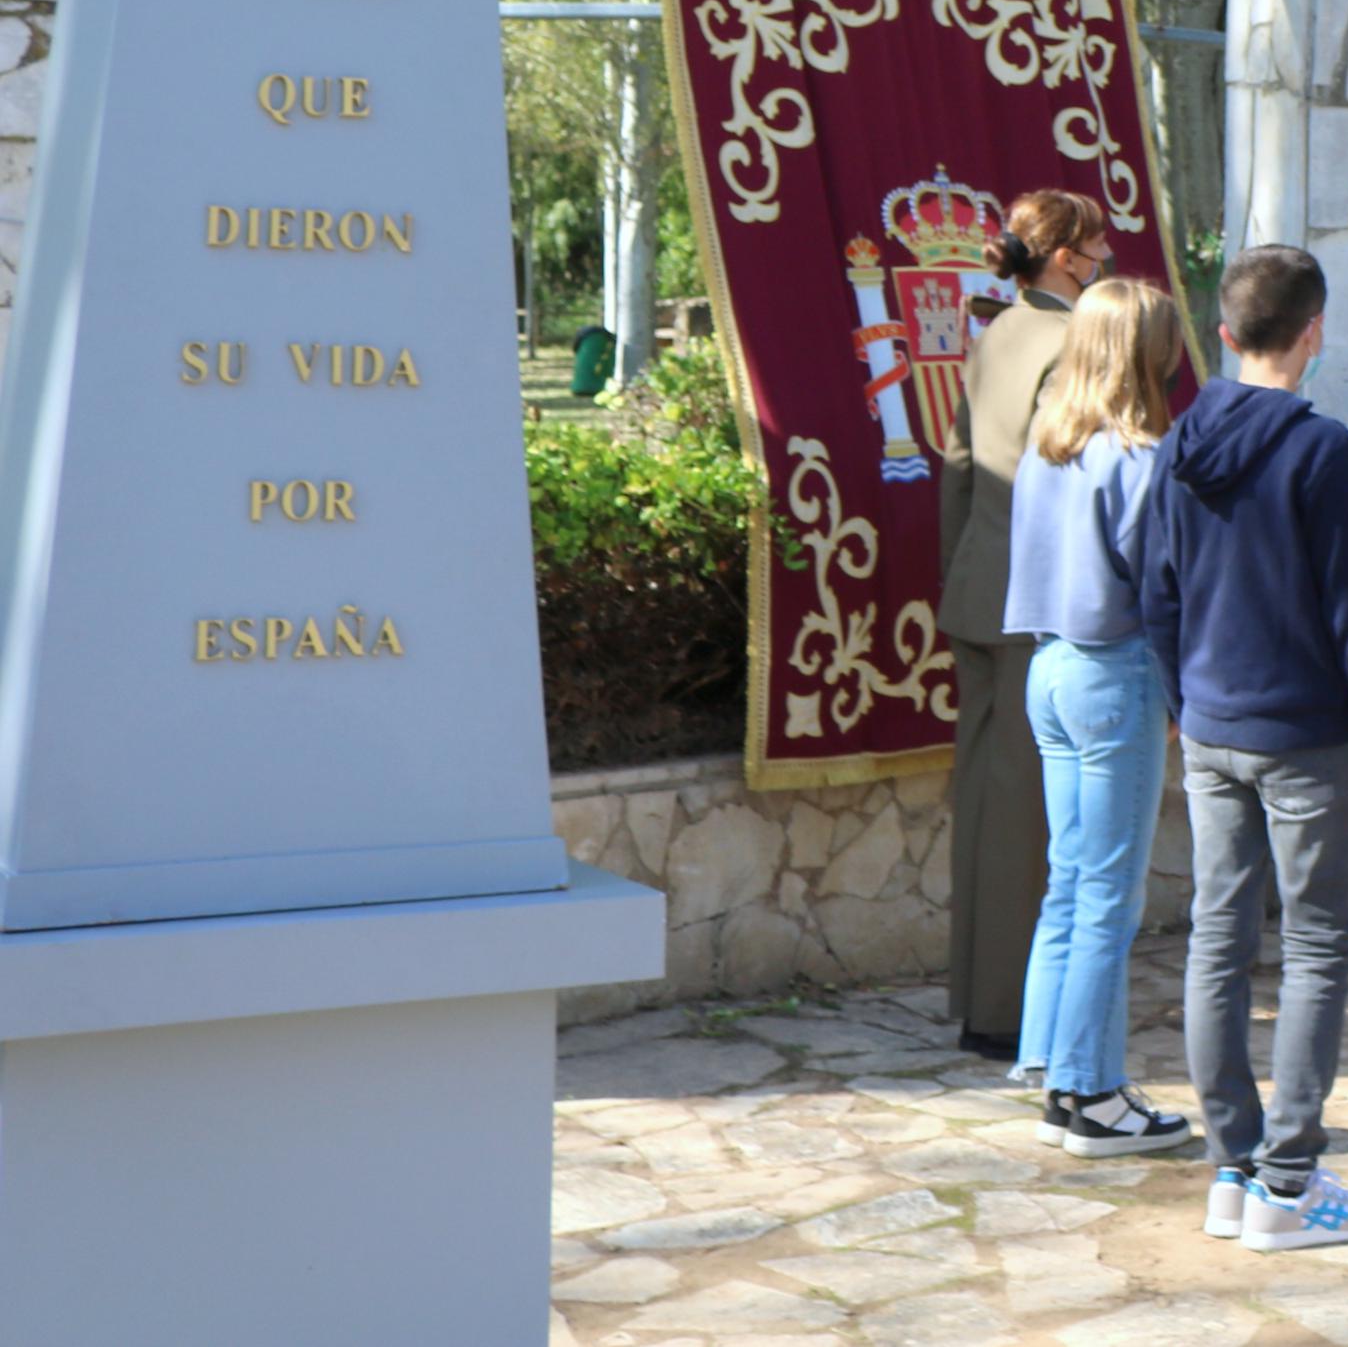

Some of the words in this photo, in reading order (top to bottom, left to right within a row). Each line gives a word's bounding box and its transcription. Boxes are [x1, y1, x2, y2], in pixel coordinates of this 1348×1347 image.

[257, 73, 371, 126] QUE
[206, 205, 414, 254] DIERON
[180, 341, 246, 387] SU
[288, 343, 421, 389] VIDA
[249, 479, 356, 524] POR
[194, 604, 405, 664] ESPAÑA
